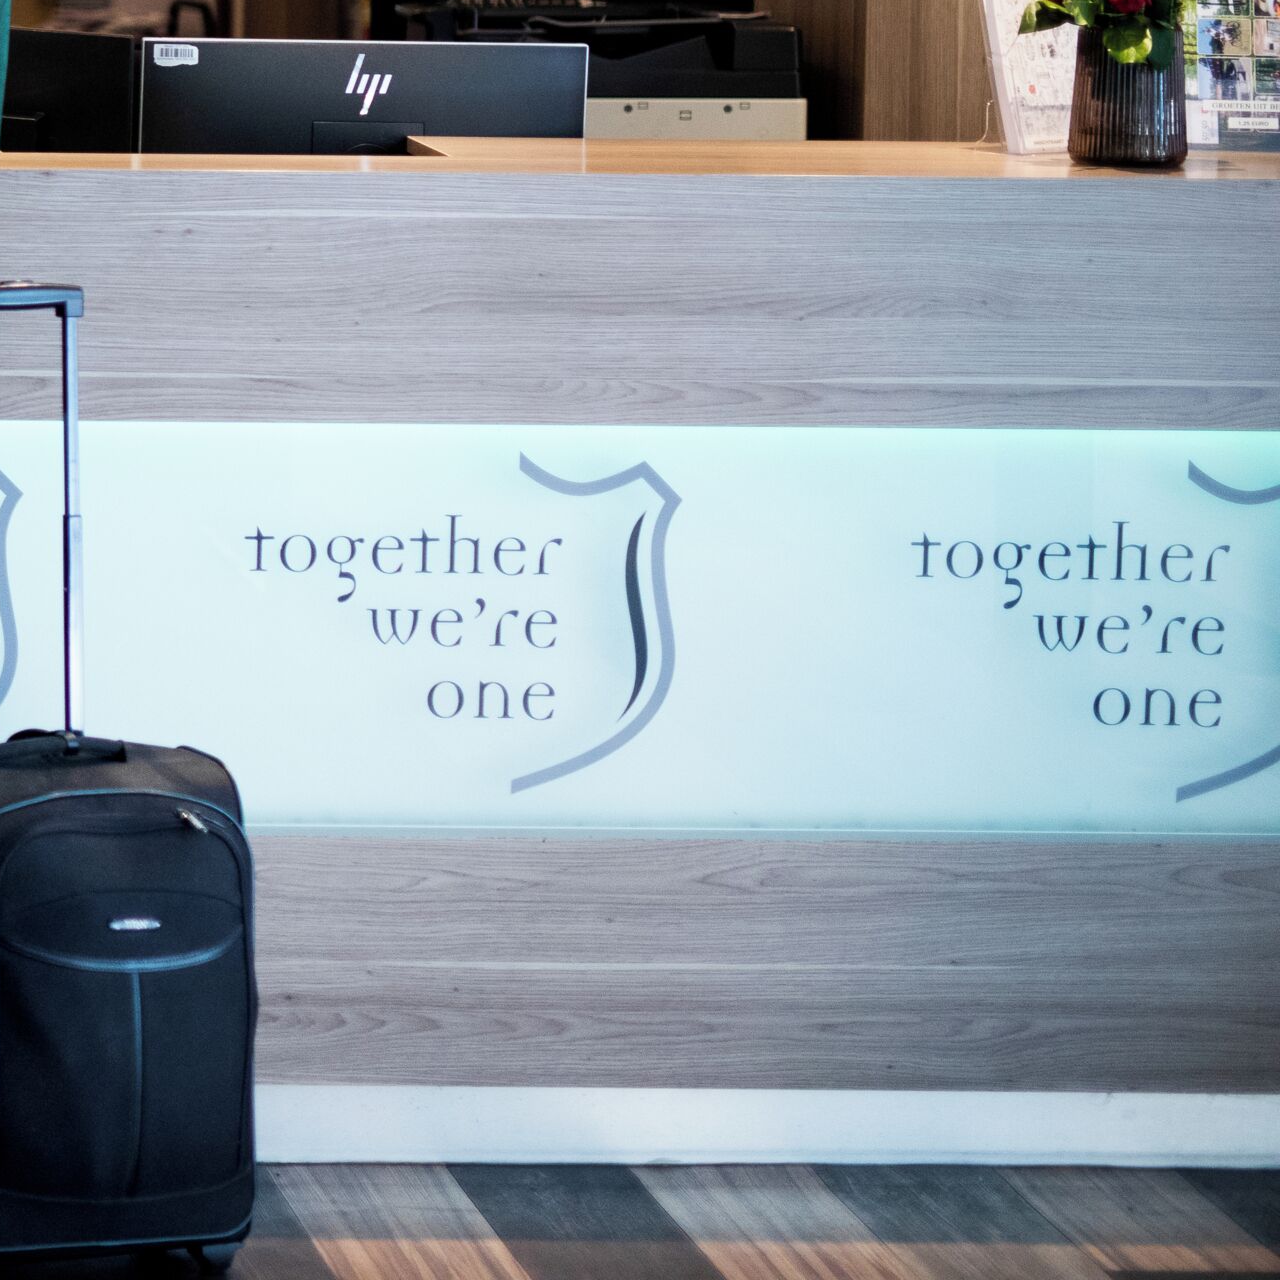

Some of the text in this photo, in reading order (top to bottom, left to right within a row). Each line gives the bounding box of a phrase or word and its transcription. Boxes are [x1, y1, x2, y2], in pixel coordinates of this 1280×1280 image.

[345, 53, 393, 115] hp
[243, 514, 563, 603] together
[911, 521, 1231, 610] together
[426, 680, 556, 721] one
[1093, 687, 1222, 728] one
